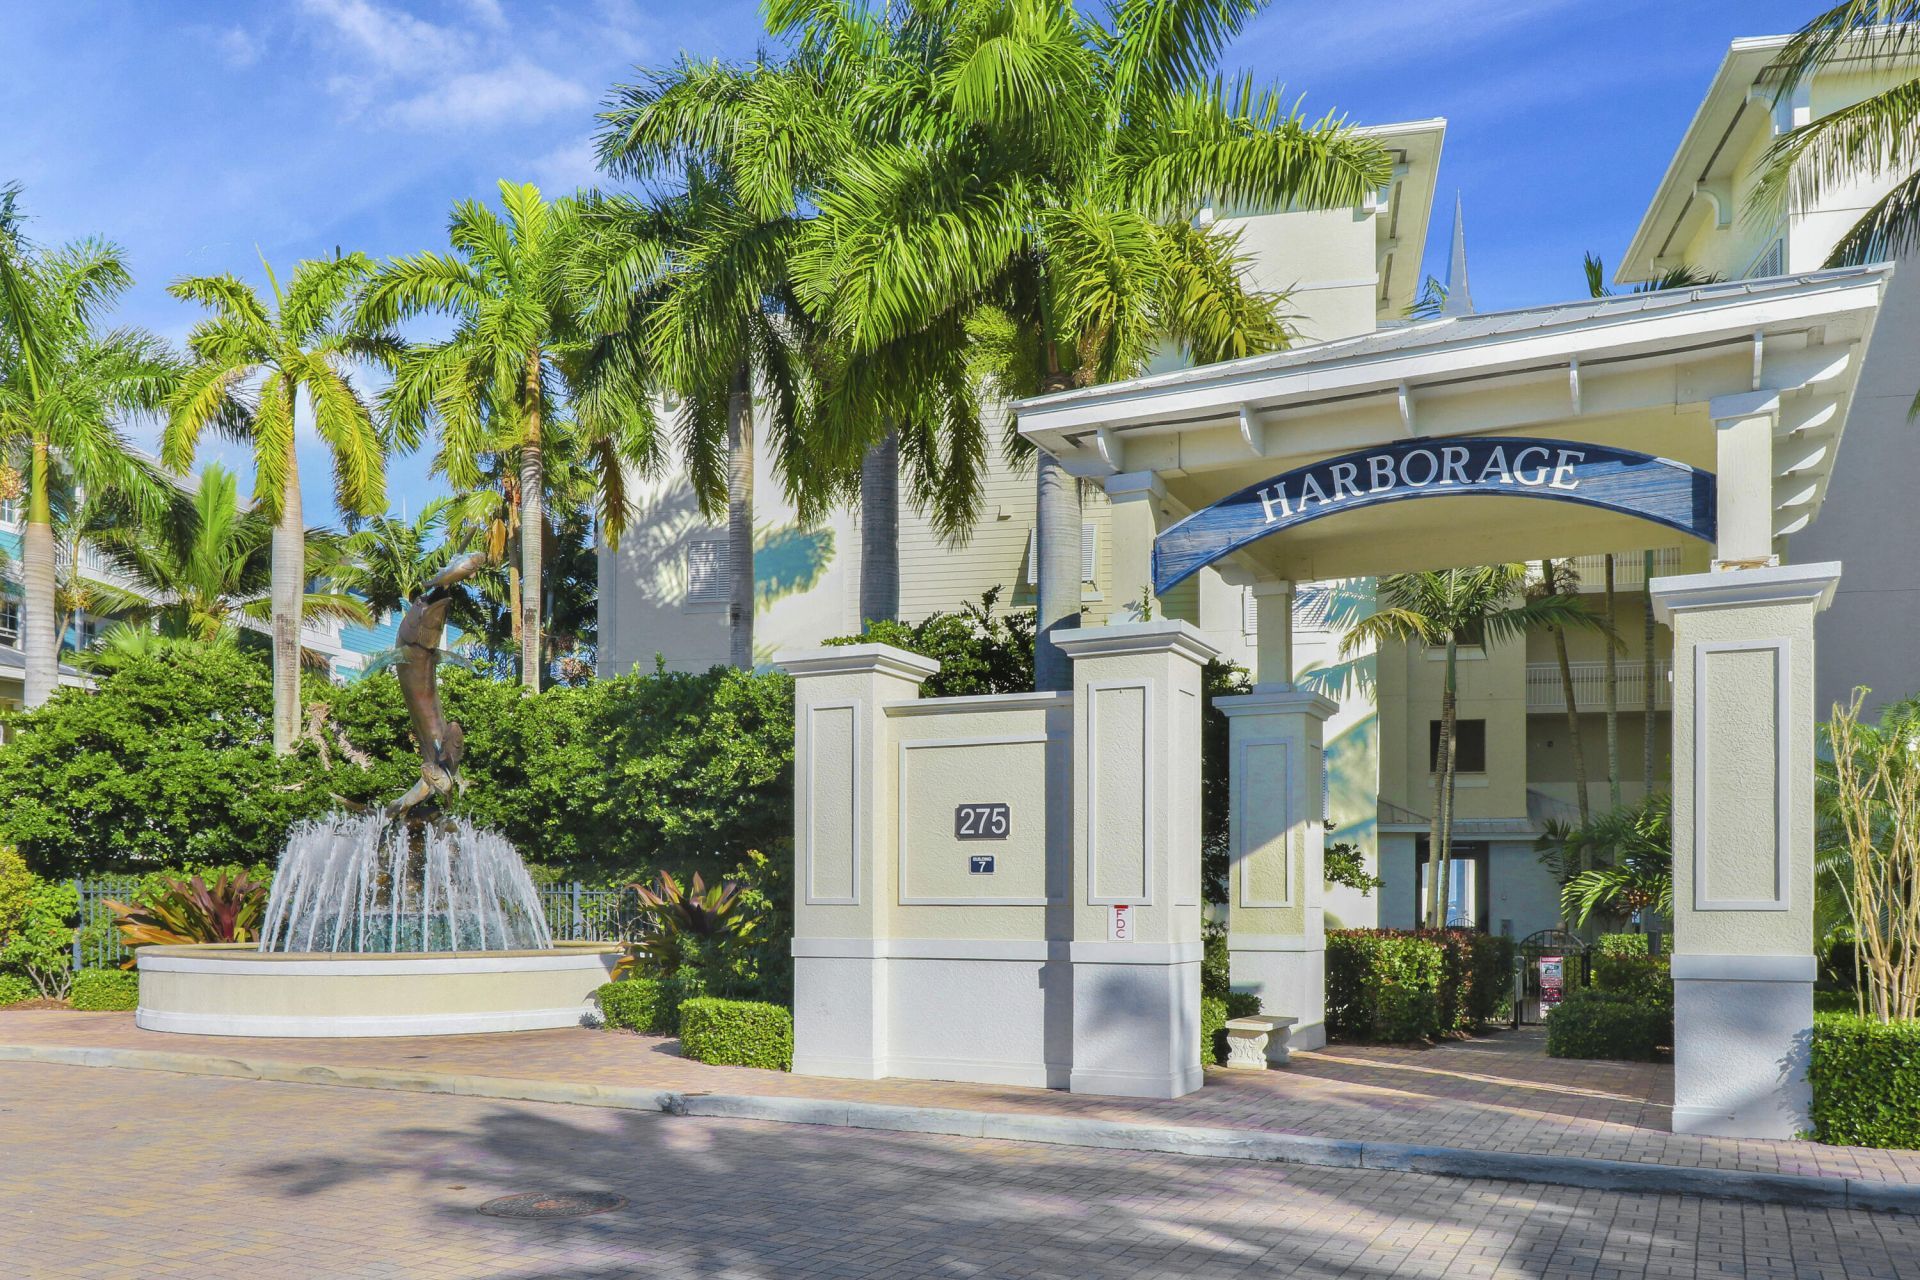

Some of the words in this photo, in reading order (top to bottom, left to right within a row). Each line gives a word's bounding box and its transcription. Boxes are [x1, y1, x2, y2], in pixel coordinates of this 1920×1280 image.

[1256, 445, 1585, 524] HARBORAGE
[960, 808, 1006, 834] 275
[978, 861, 986, 873] 7
[1115, 909, 1126, 939] FDC
